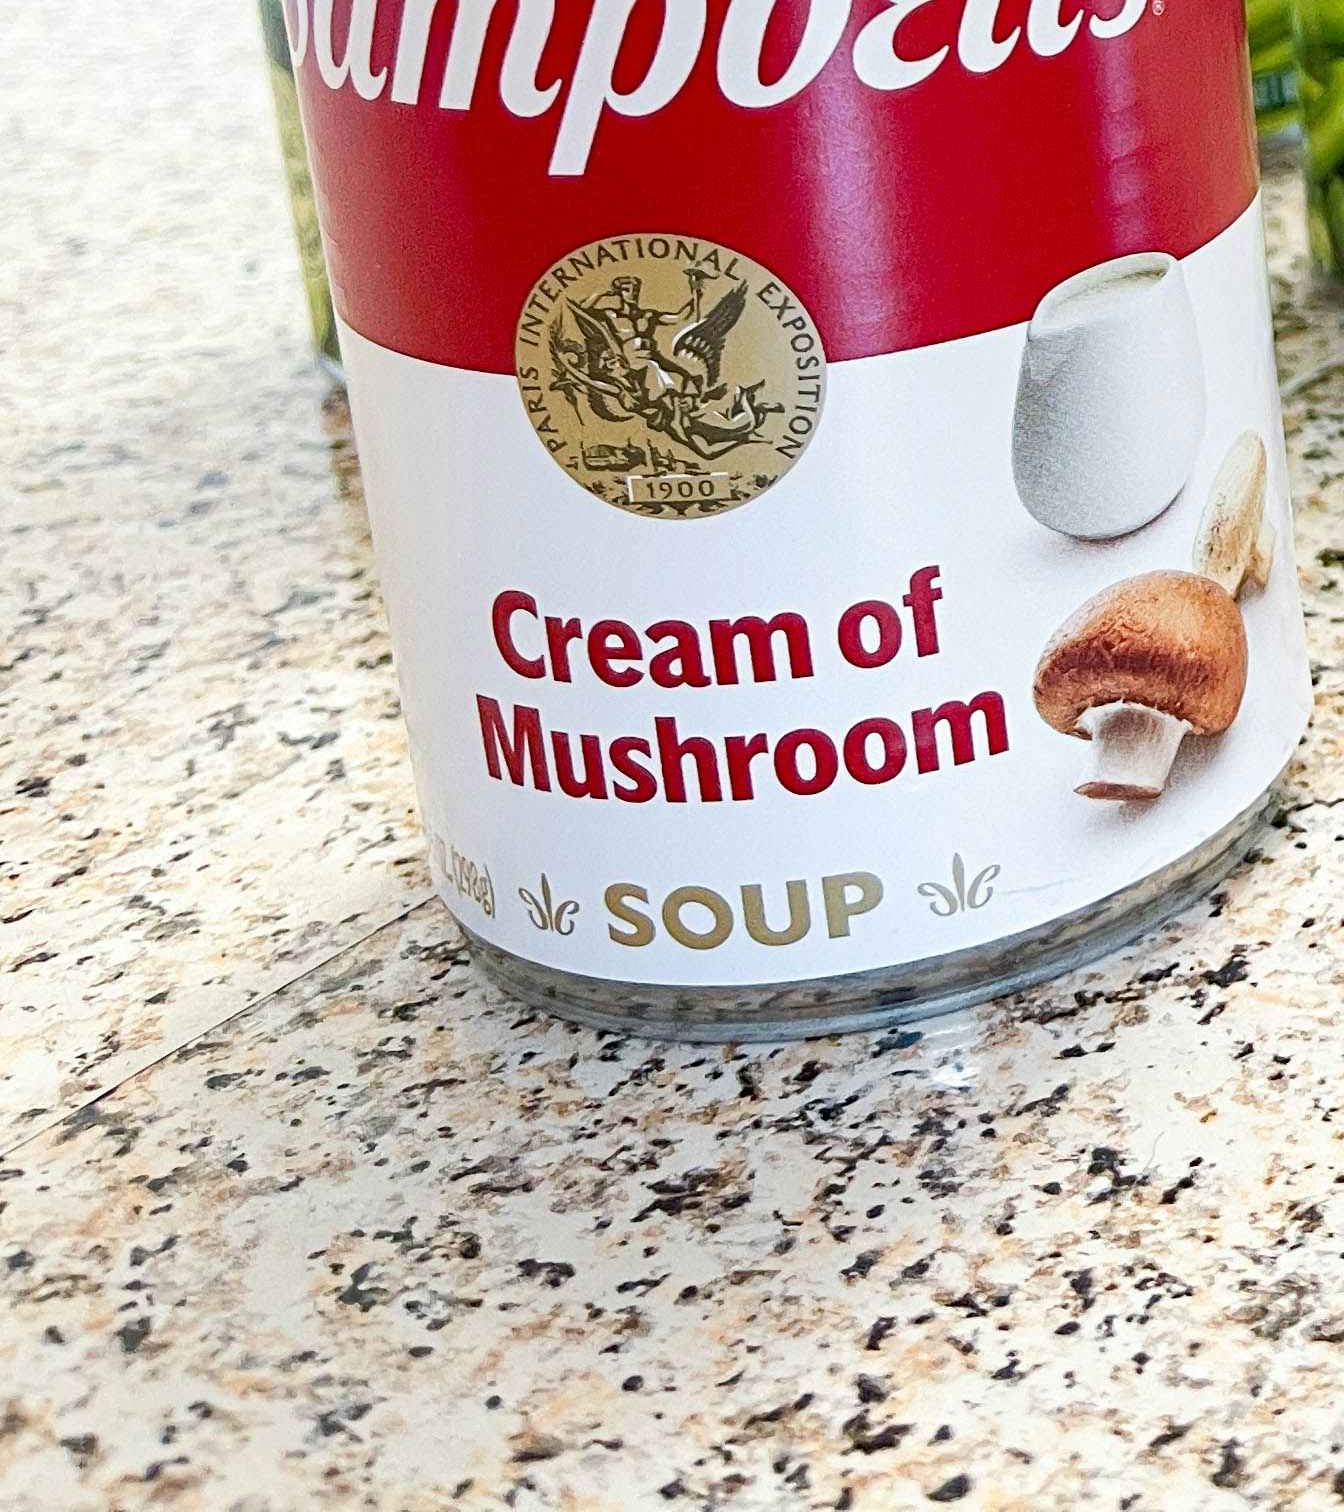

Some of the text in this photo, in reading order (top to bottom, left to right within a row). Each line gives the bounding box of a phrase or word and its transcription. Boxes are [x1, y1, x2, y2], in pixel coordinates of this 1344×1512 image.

[519, 238, 821, 460] PARIS INTERNATIONAL EXPOSITION
[646, 480, 715, 499] 1900
[491, 566, 944, 689] Cream of
[475, 689, 1010, 803] Mushroom
[606, 872, 885, 951] SOUP
